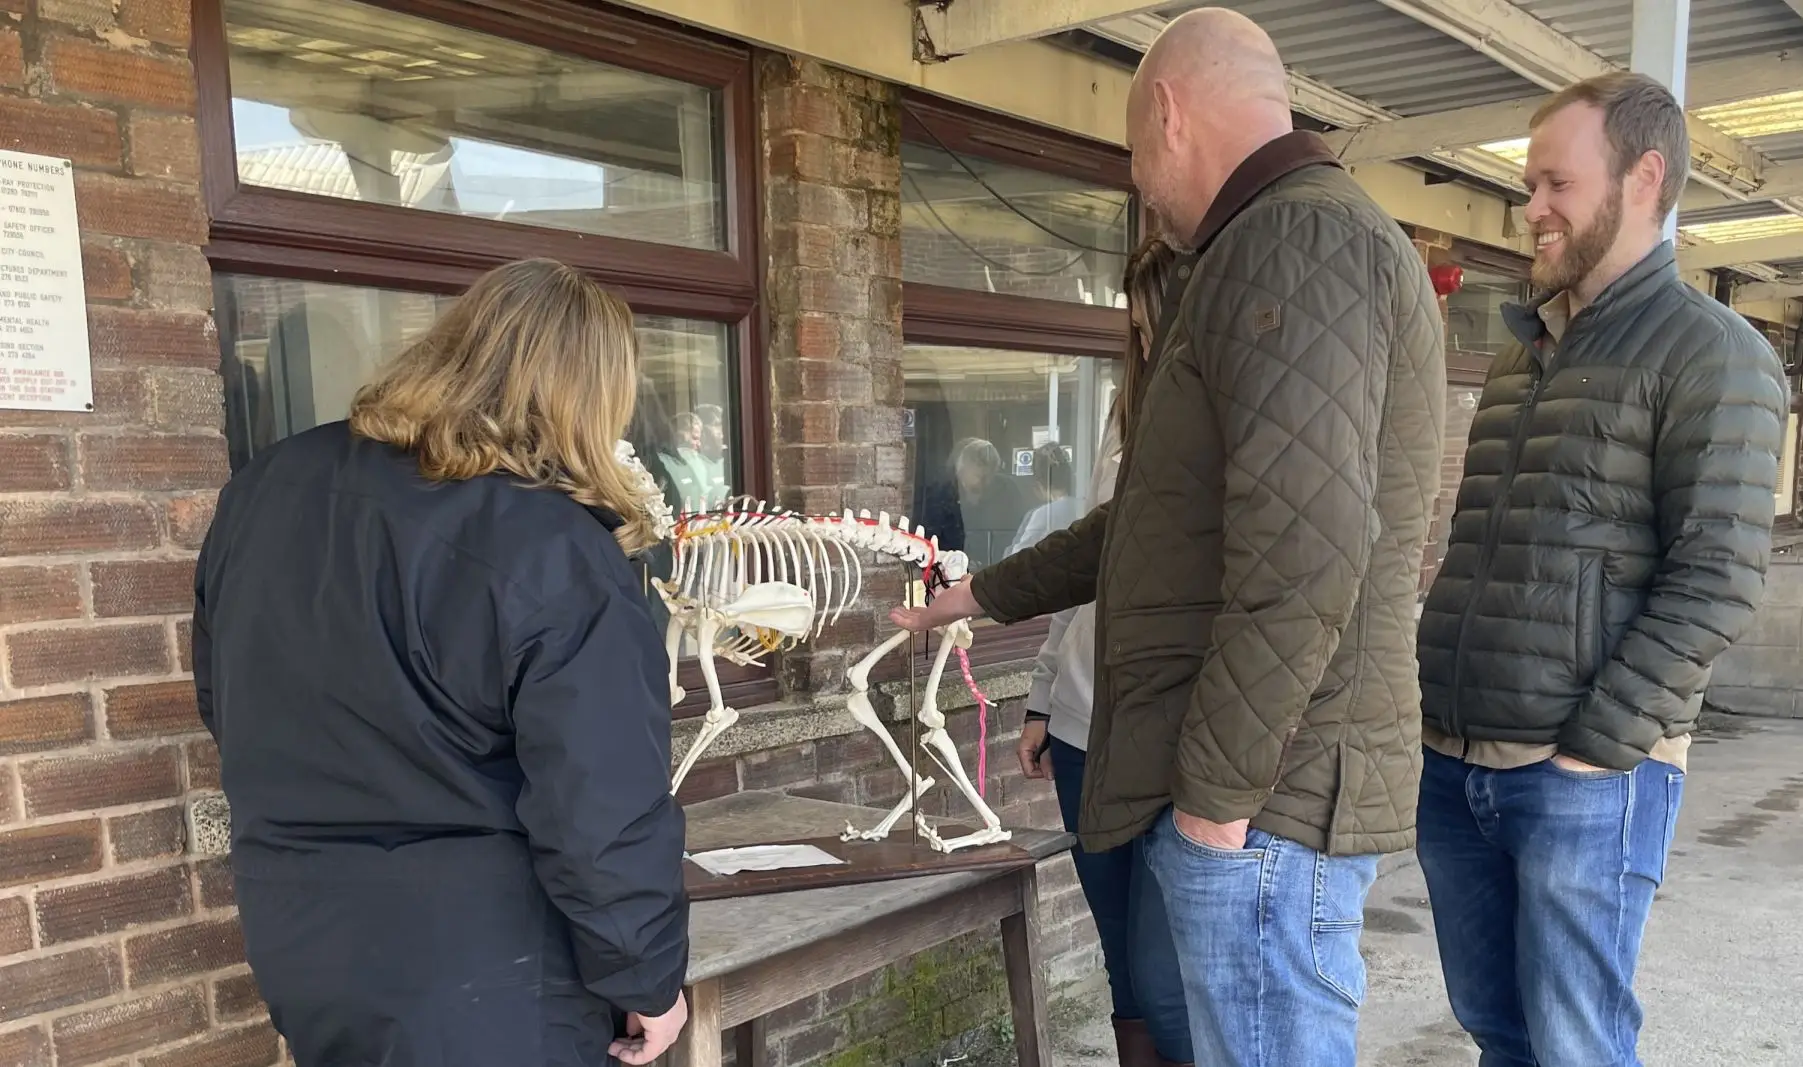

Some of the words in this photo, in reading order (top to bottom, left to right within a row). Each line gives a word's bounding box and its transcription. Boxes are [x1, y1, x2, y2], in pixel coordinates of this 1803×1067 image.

[28, 162, 65, 176] NUMBERS
[18, 180, 55, 192] PROTECTION
[4, 221, 26, 231] SAFETY
[18, 248, 44, 259] COUNCIL
[28, 266, 68, 278] DEPARTMENT
[15, 291, 37, 301] PUBLIC
[40, 293, 64, 303] SAFETY
